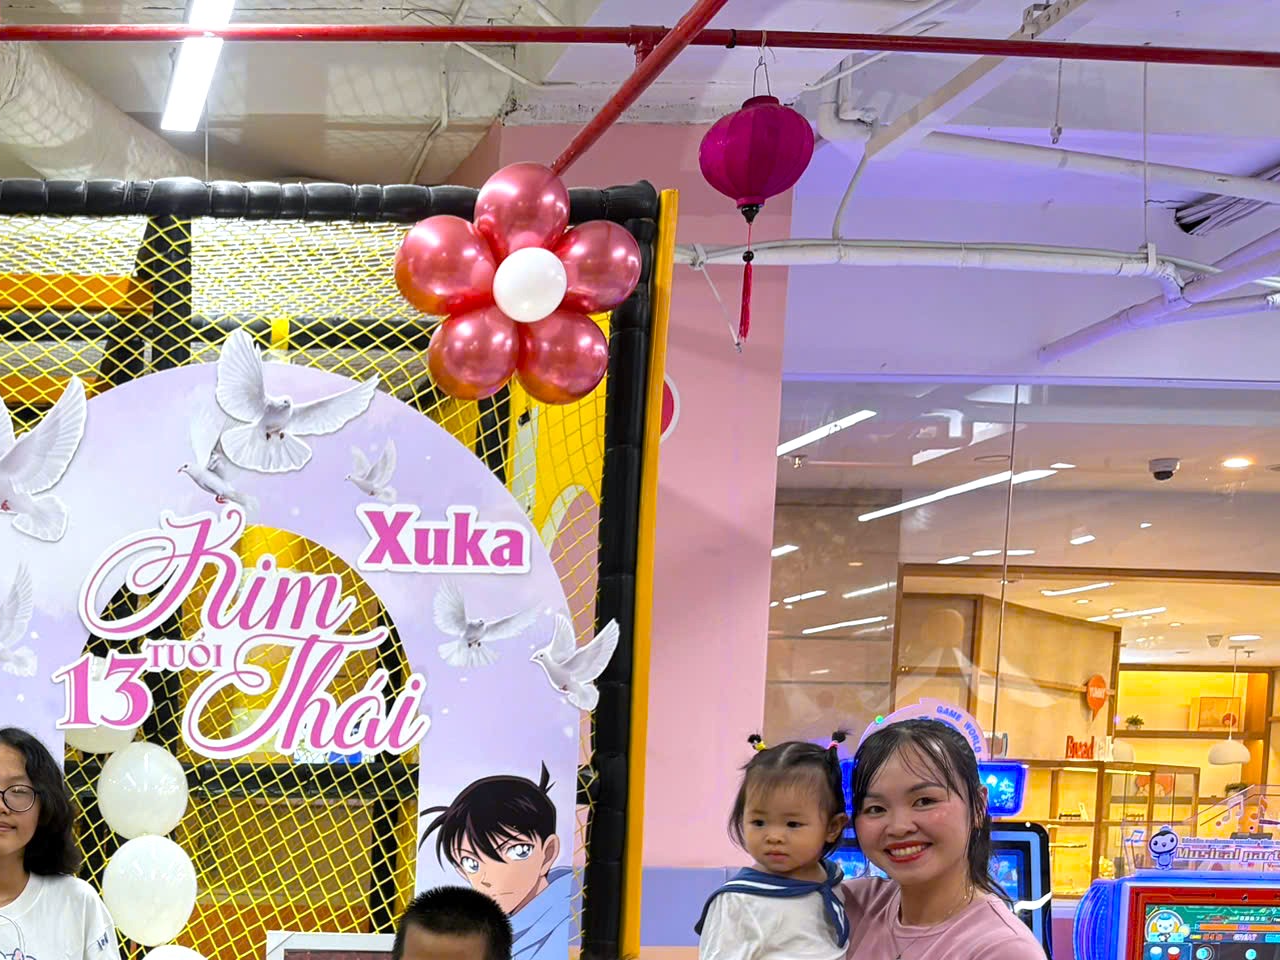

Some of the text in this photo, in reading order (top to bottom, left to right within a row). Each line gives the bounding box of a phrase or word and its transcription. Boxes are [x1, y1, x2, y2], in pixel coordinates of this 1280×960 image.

[84, 508, 358, 636] Kim
[362, 509, 526, 568] Xuka
[55, 652, 154, 728] 13
[188, 630, 429, 753] Thái
[936, 705, 982, 753] GAME WORLD
[1176, 847, 1240, 860] Musical
